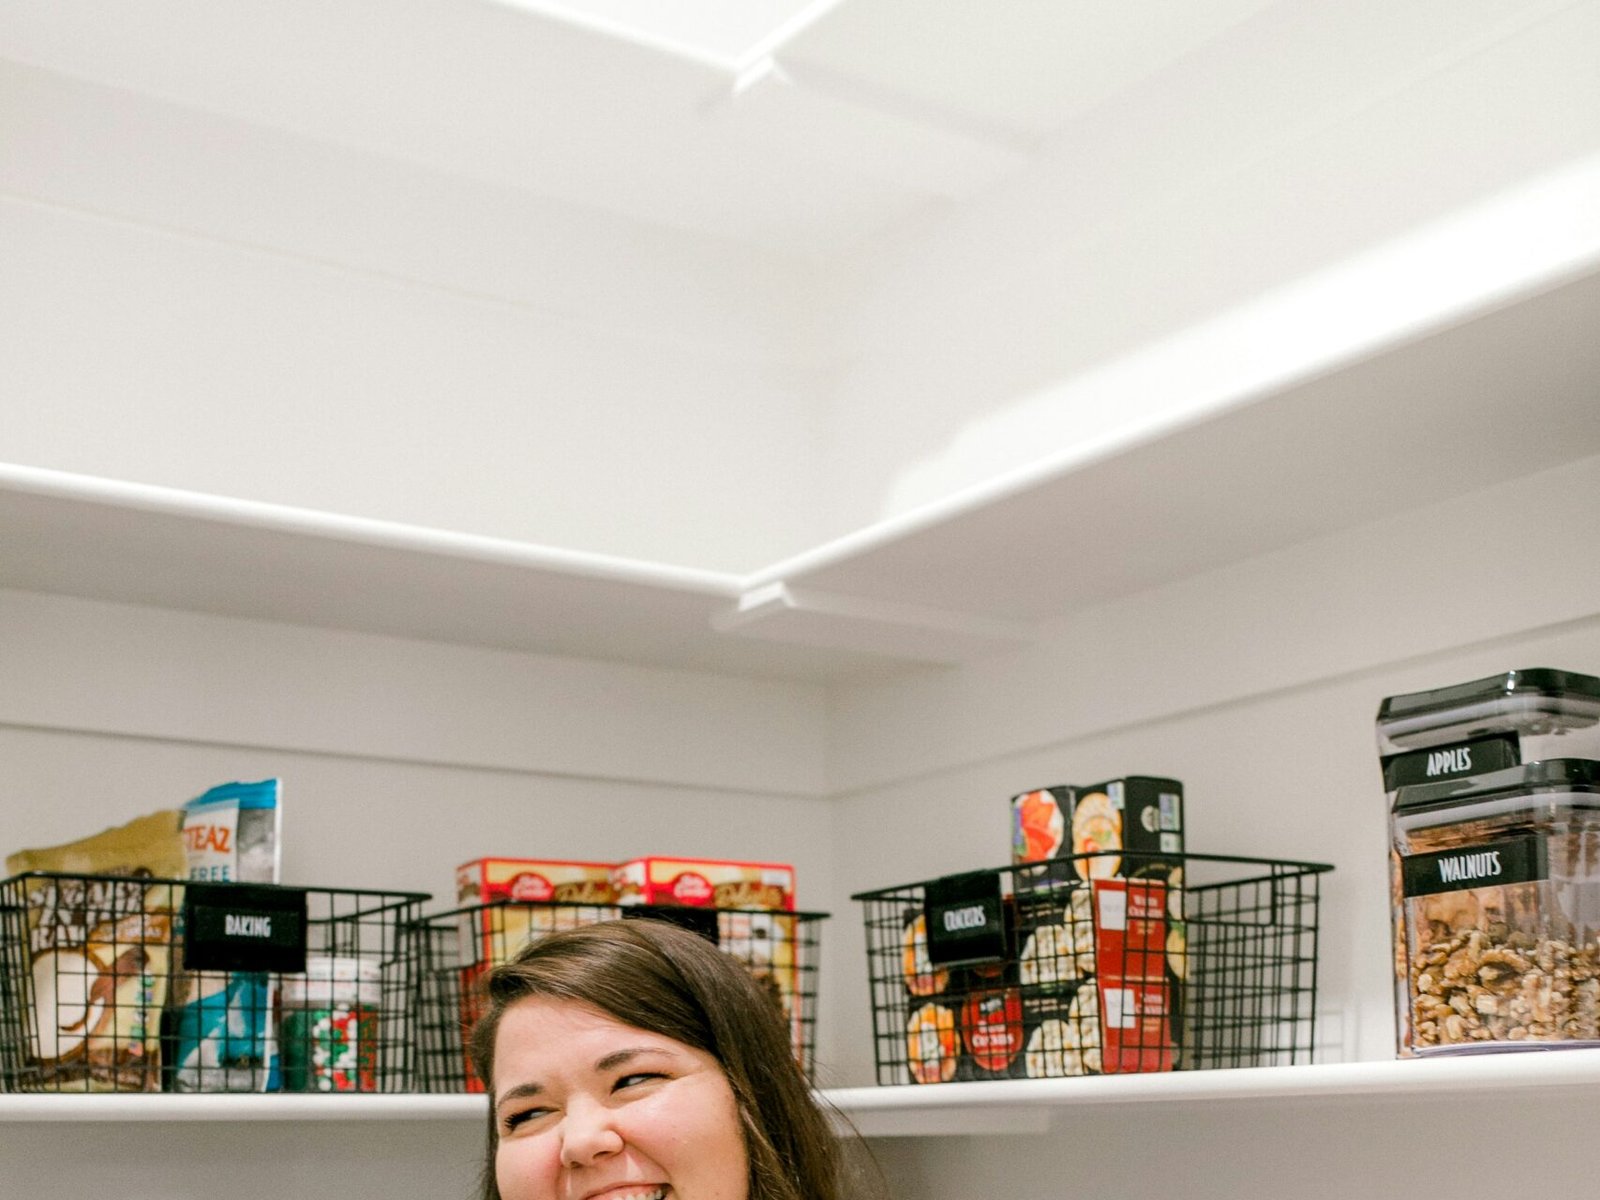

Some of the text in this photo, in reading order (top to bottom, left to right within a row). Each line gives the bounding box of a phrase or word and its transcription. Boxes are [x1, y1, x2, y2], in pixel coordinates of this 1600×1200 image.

[1426, 747, 1472, 776] APPLES
[1438, 850, 1502, 883] WALNUTS
[225, 914, 271, 937] BAKING
